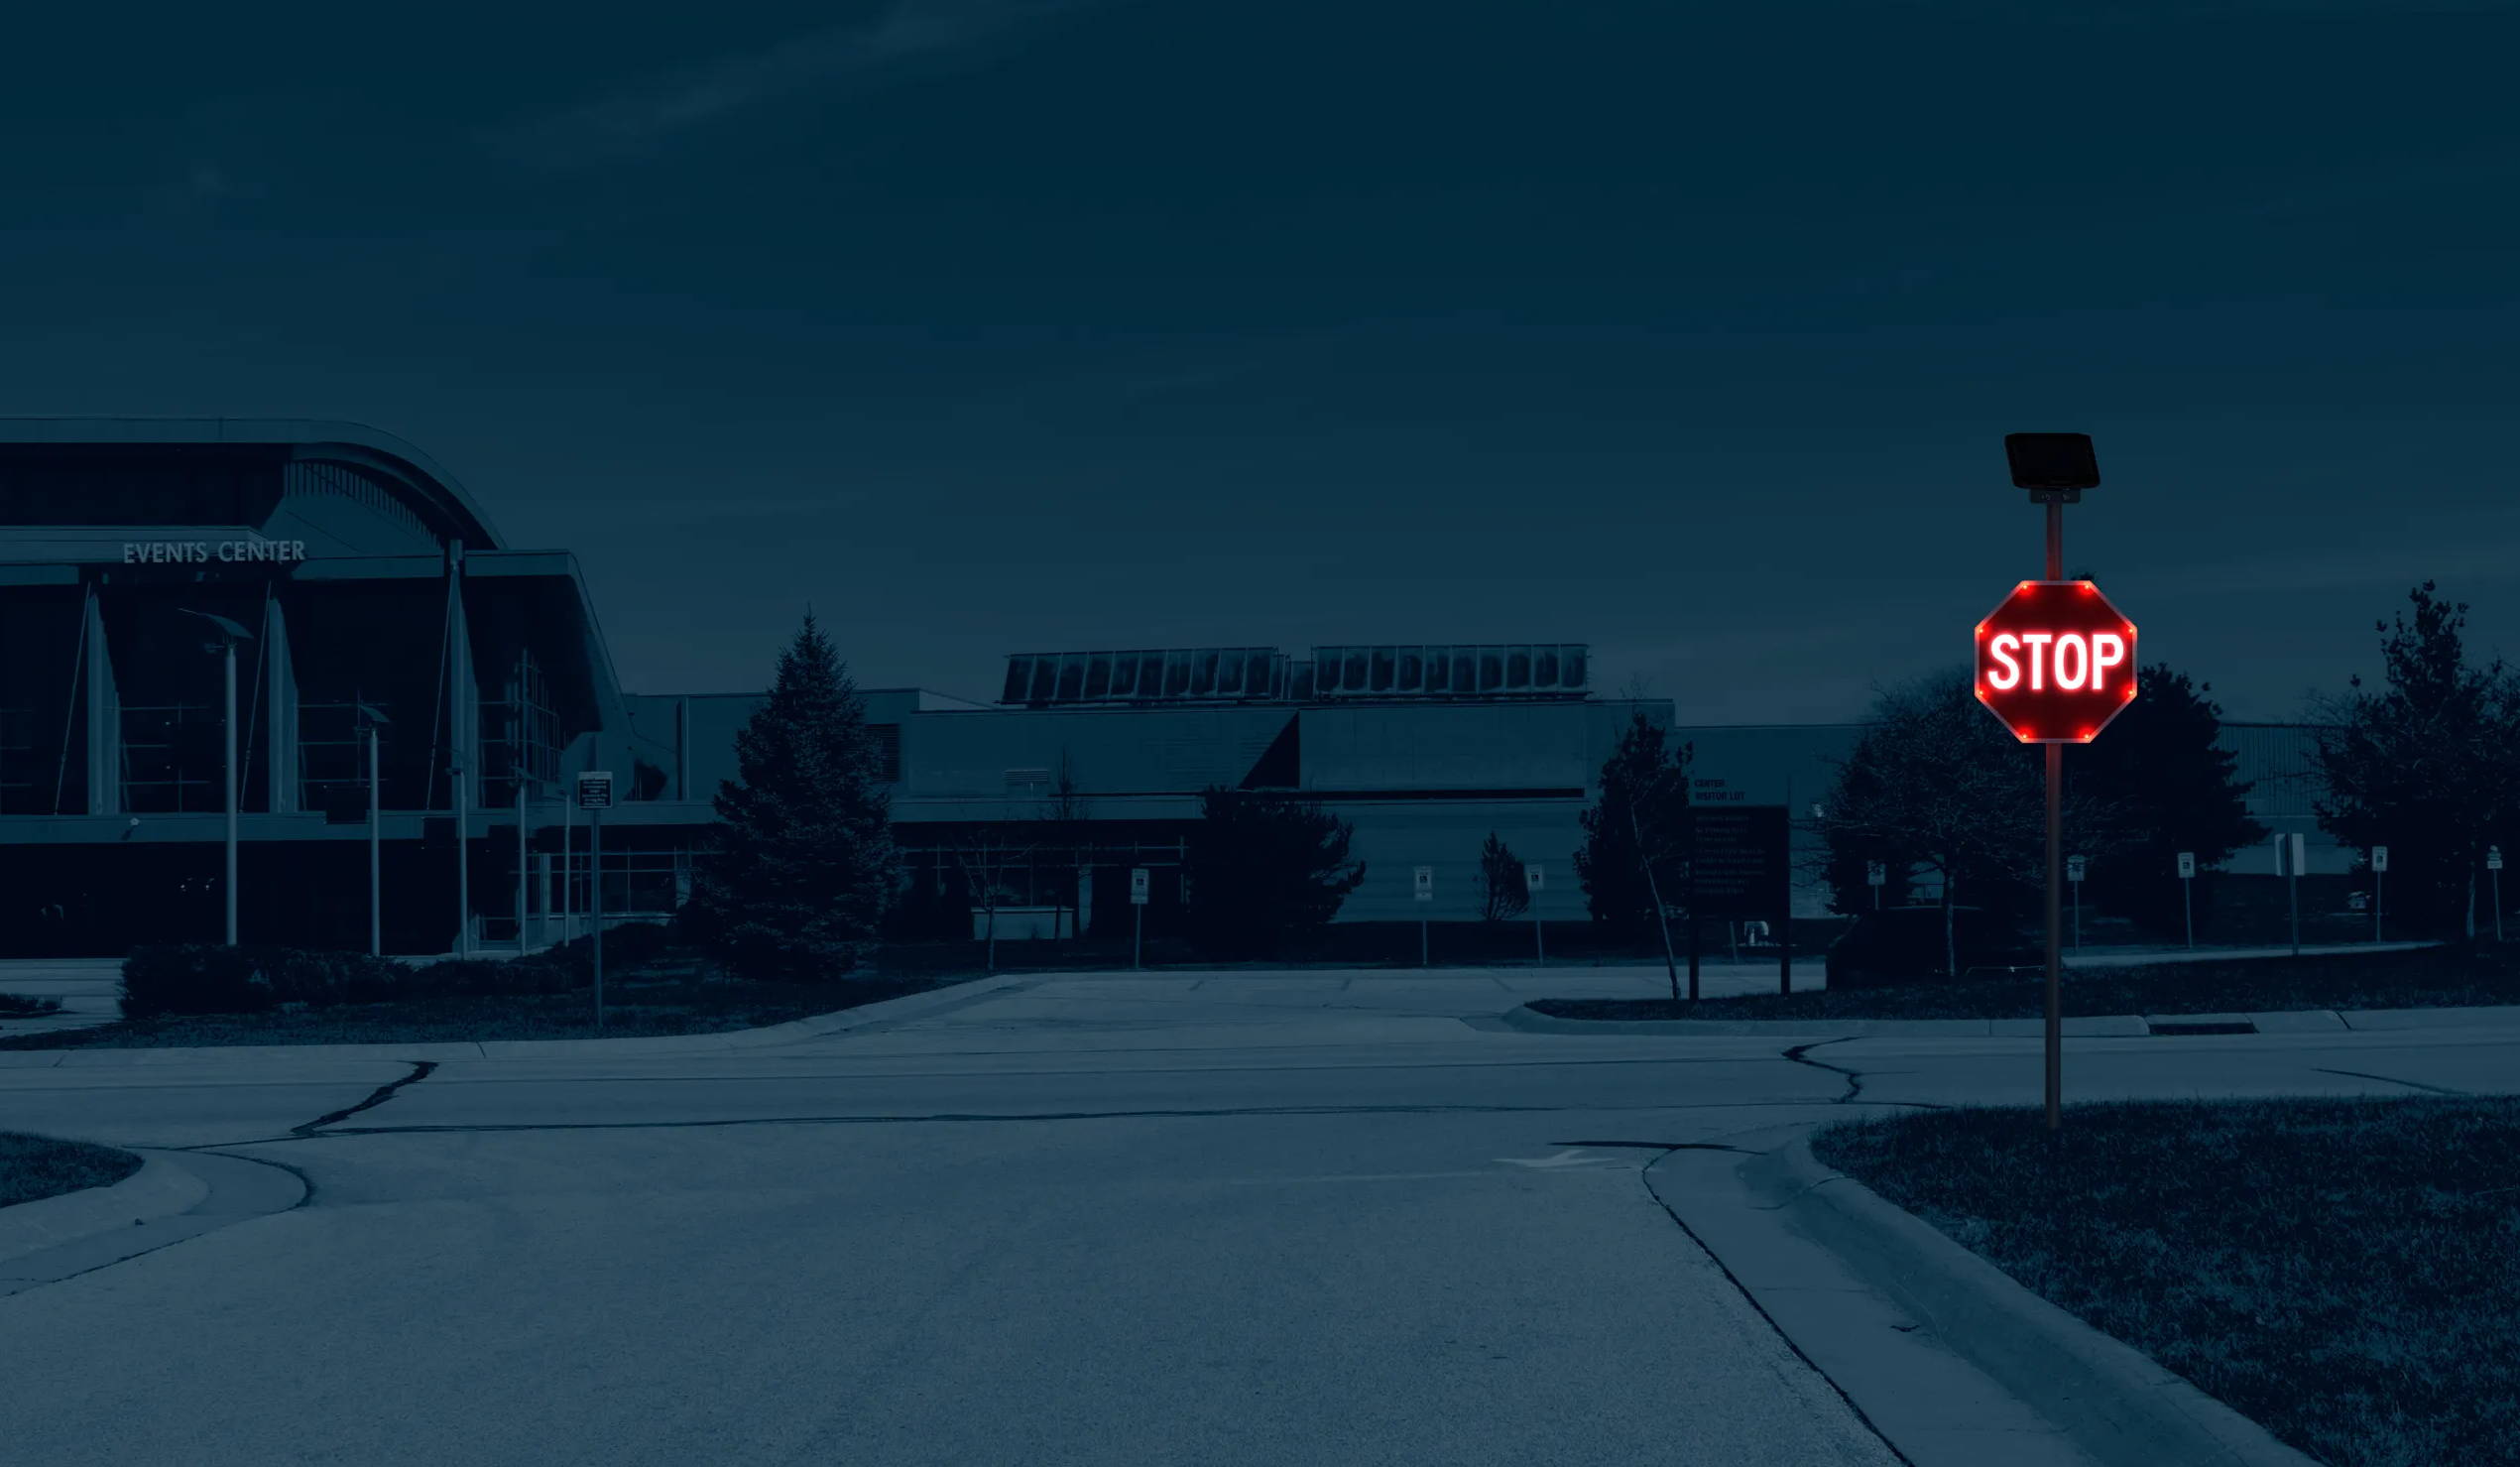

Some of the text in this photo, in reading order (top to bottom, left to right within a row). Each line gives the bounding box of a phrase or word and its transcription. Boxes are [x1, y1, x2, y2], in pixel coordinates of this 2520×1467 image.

[123, 540, 305, 563] EVENTS CENTER
[1987, 634, 2124, 690] STOP
[1730, 792, 1746, 801] LOT
